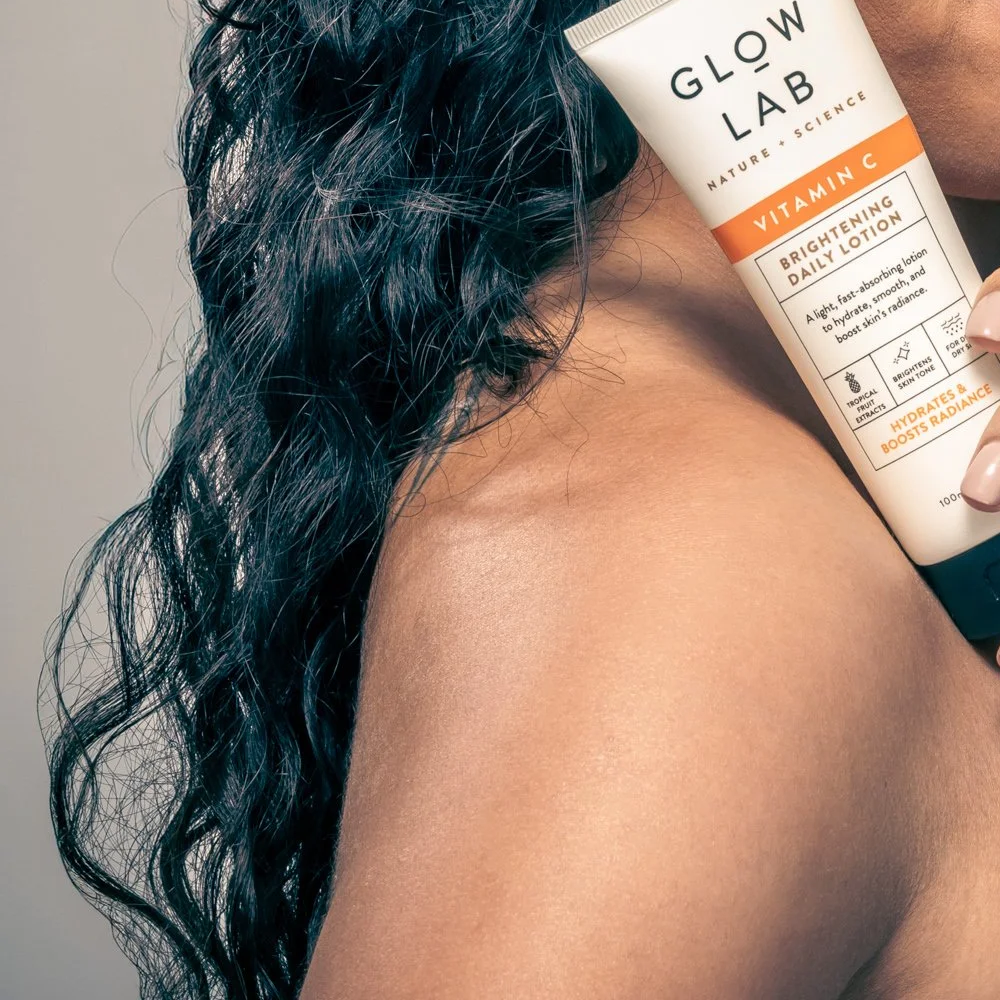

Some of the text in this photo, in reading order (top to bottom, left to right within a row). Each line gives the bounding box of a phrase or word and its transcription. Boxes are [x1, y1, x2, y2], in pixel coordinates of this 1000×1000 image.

[671, 0, 805, 100] GLOW
[722, 70, 814, 141] LAB
[707, 148, 770, 191] NATURE
[794, 91, 866, 138] SCIENCE
[753, 153, 877, 232] VITAMIN C
[779, 195, 893, 271] BRIGHTENING
[787, 211, 902, 286] DAILY LOTION
[806, 248, 928, 324] A light, fast-absorbing lotion
[822, 265, 926, 333] to hydrate, smooth, and
[835, 325, 862, 343] boost
[888, 287, 928, 313] radiance.
[892, 356, 933, 382] BRIGHTENS
[946, 340, 960, 351] FOR
[952, 347, 965, 358] DRY
[846, 389, 878, 408] TROPICAL
[857, 399, 875, 413] FRUIT
[890, 384, 967, 432] HYDRATES &
[898, 364, 936, 390] SKIN TONE
[855, 403, 887, 424] EXTRACTS
[881, 383, 992, 454] BOOSTS RADIANCE
